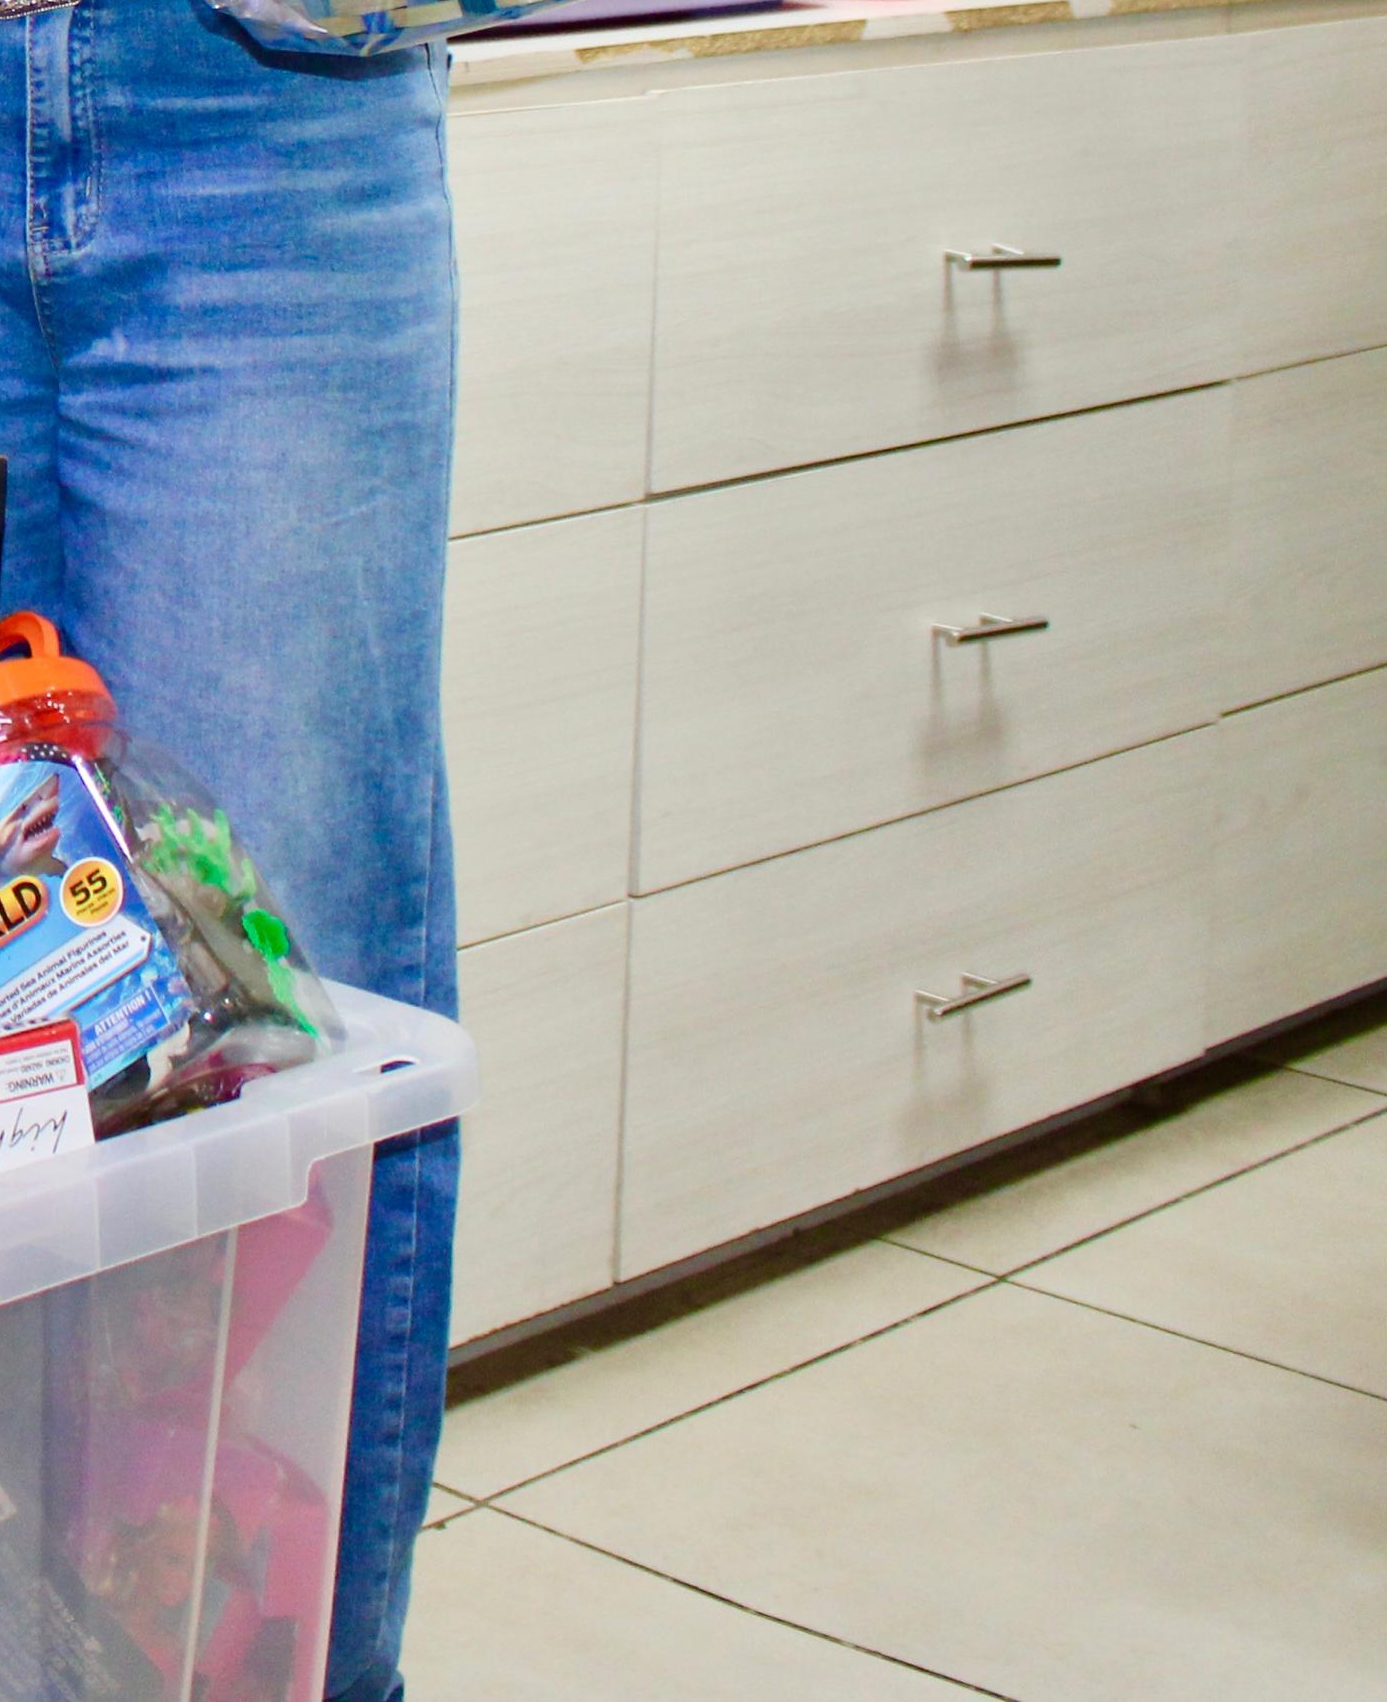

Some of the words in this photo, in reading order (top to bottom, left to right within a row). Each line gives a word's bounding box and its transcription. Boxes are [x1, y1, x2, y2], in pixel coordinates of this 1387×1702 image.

[69, 868, 108, 906] 55
[10, 996, 46, 1024] Variadas
[46, 988, 58, 1000] de
[58, 962, 98, 991] Animales
[98, 951, 112, 966] del
[112, 940, 130, 956] Mar
[11, 977, 55, 1011] d'Animaux
[56, 957, 86, 979] Marins
[86, 930, 126, 959] Assorties
[20, 977, 36, 990] Sea
[36, 955, 67, 979] Animal
[66, 930, 107, 960] Figurines
[94, 992, 145, 1036] ATTENTION
